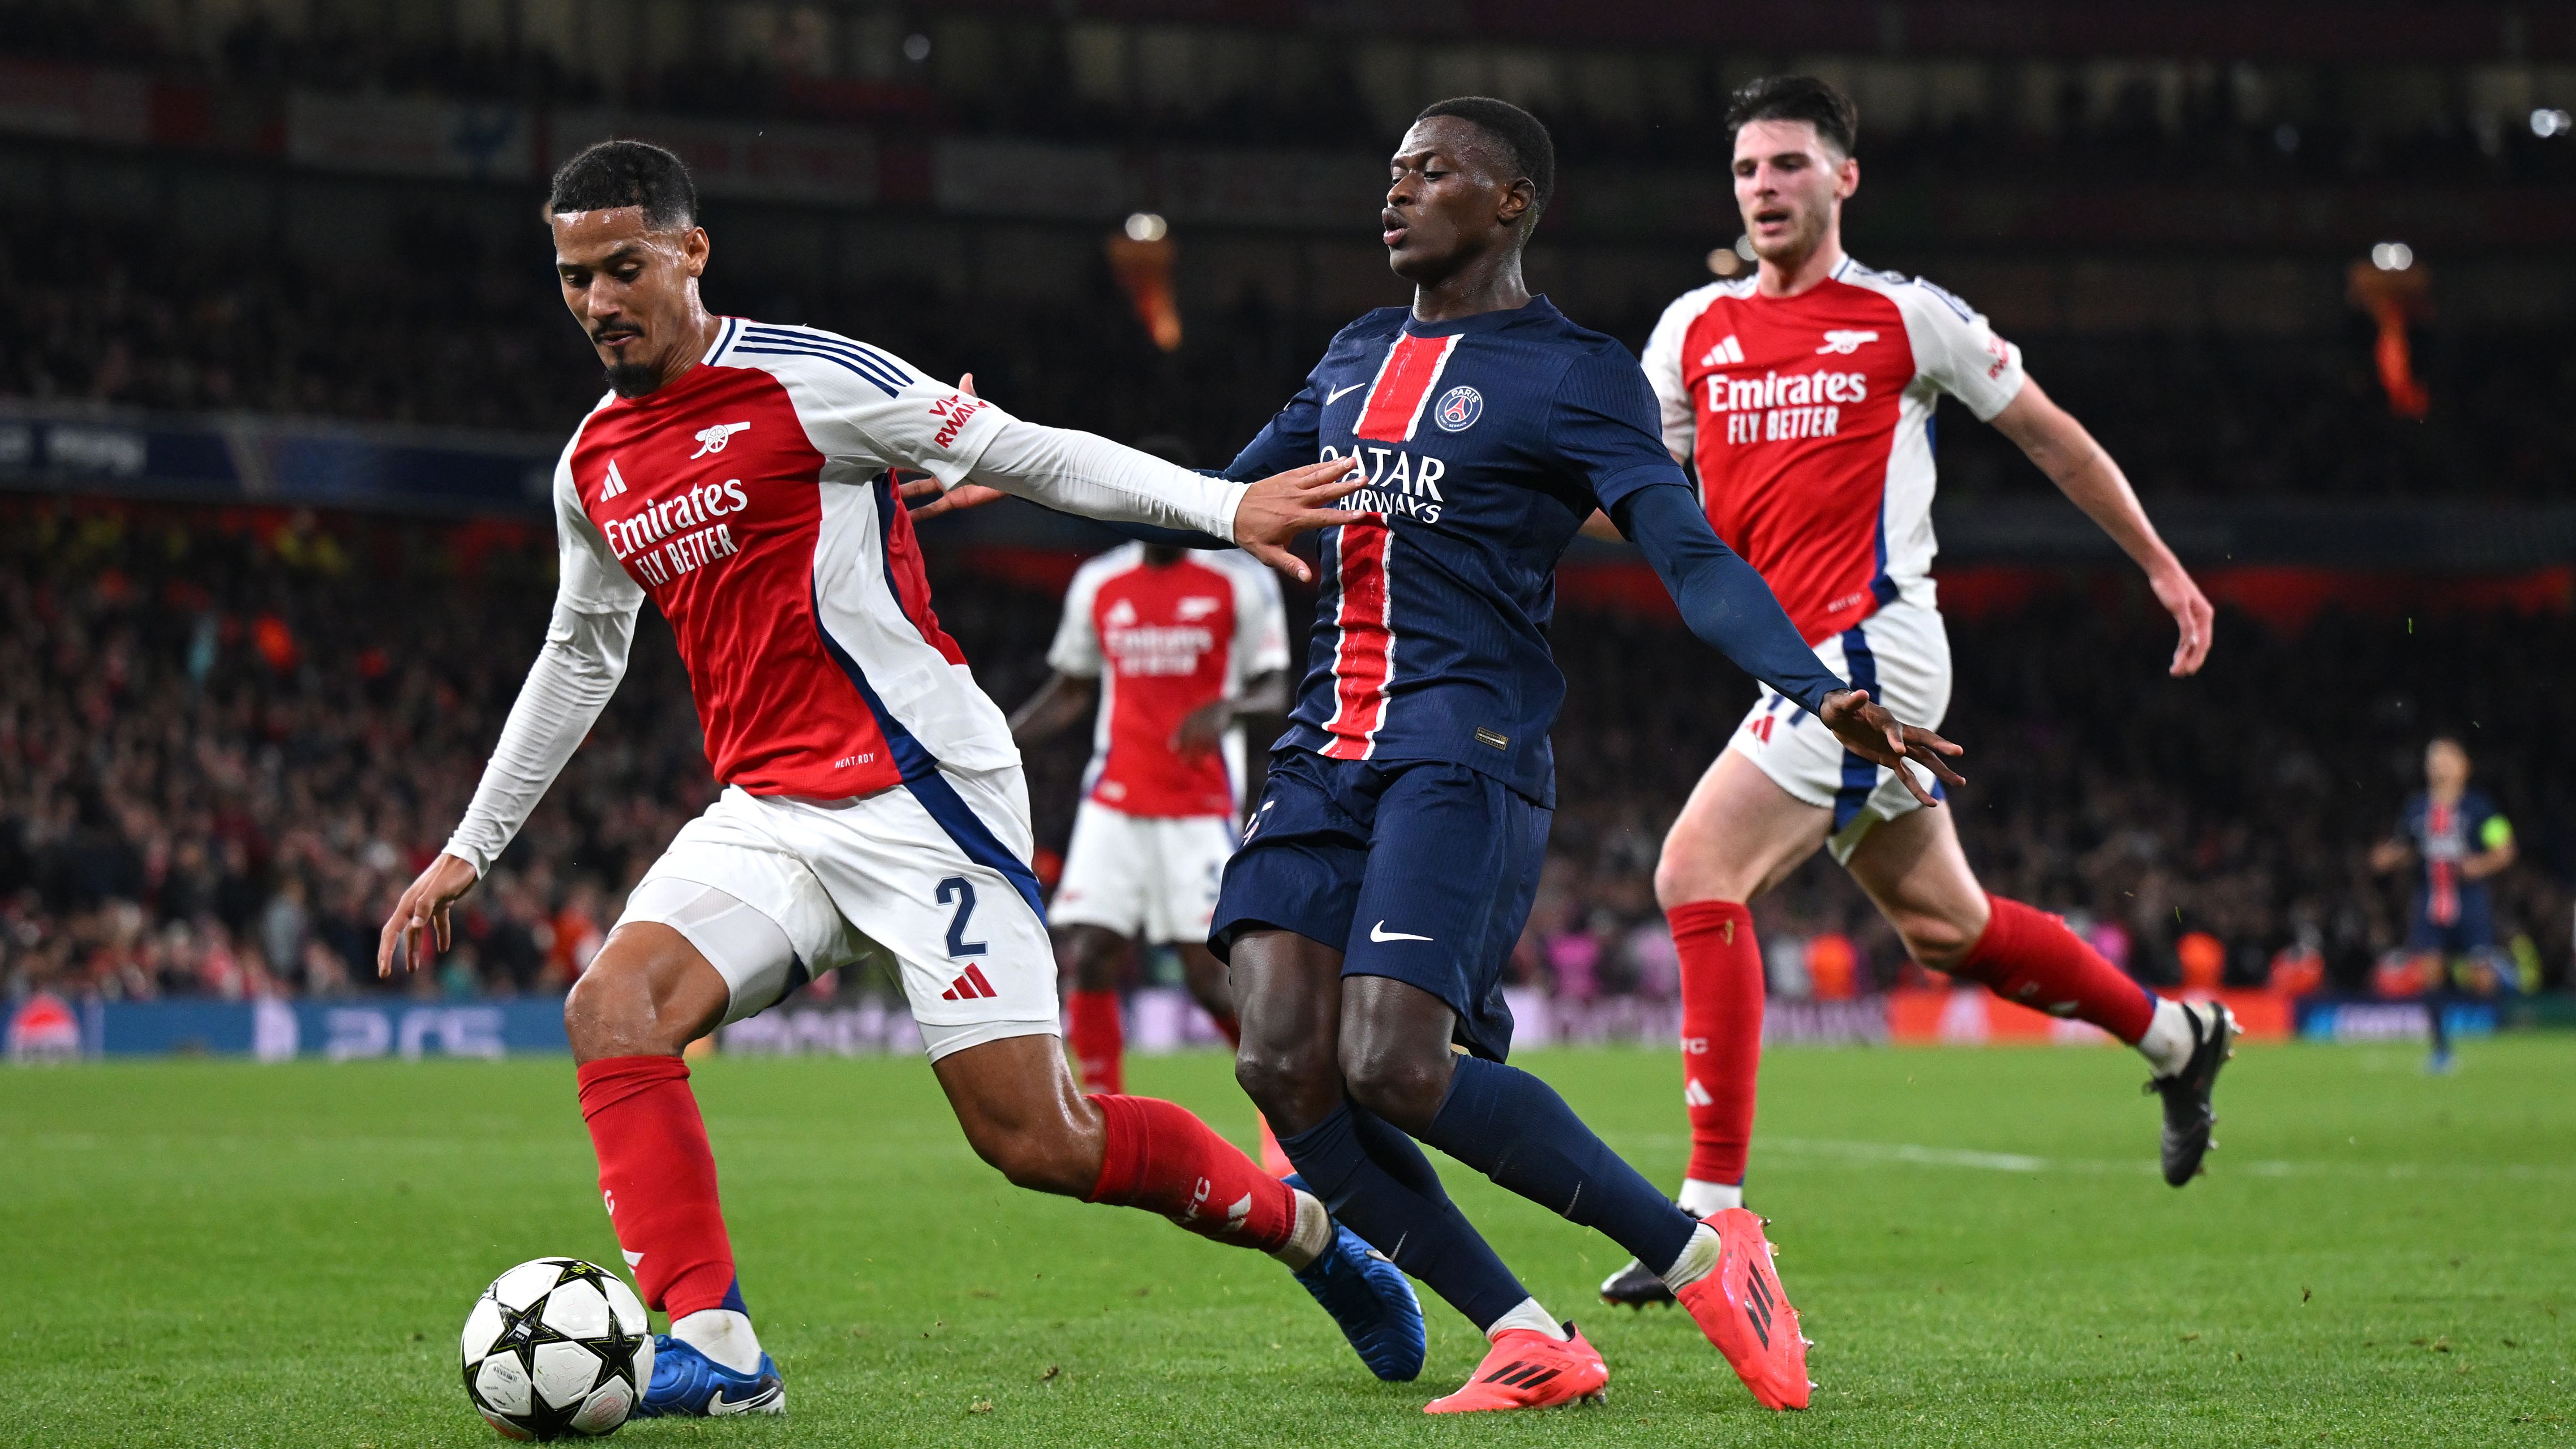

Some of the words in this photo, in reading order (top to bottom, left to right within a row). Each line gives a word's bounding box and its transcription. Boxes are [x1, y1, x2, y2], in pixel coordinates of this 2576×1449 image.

[1451, 389, 1479, 403] PARIS
[1706, 369, 1867, 412] Emirates
[1728, 412, 1761, 445] FLY
[1766, 405, 1839, 441] BETTER
[604, 479, 748, 561] Emirates
[635, 549, 670, 587] FLY
[665, 523, 739, 575] BETTER
[835, 753, 874, 769] HEAT.RDY
[933, 875, 988, 960] 2
